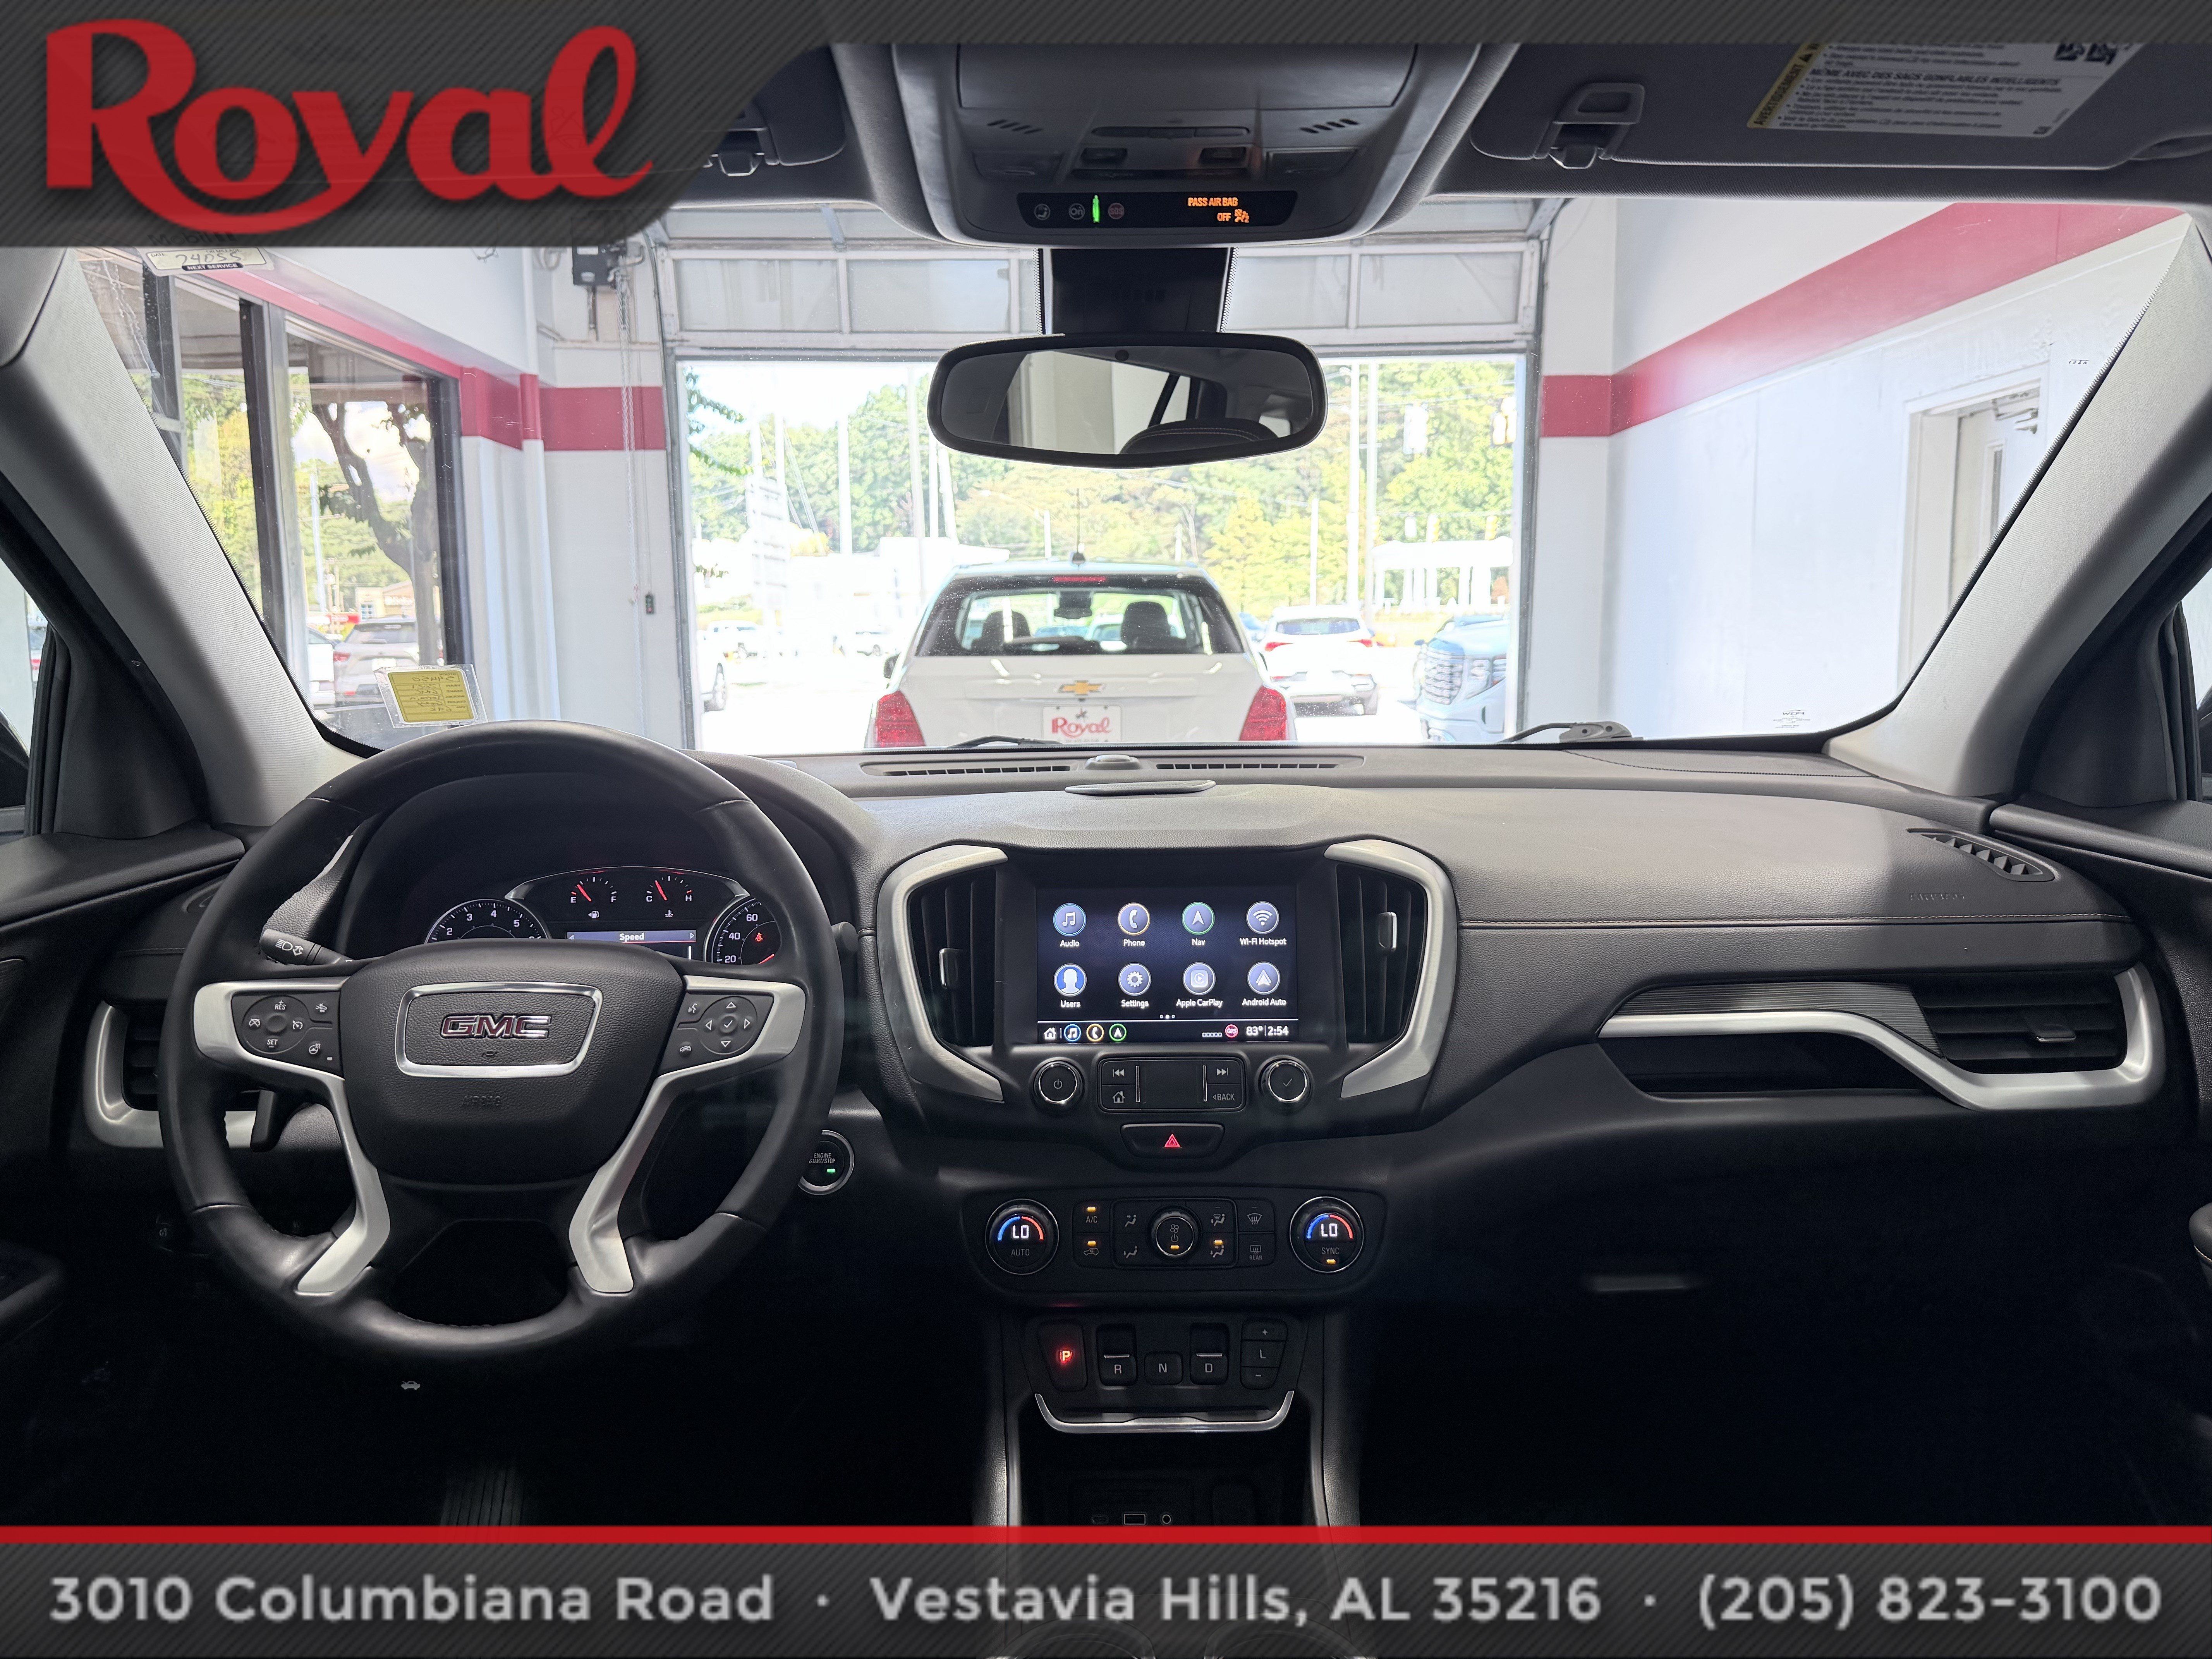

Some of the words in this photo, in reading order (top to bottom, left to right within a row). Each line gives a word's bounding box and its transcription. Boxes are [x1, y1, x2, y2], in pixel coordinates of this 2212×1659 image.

[1188, 198, 1207, 207] PASS
[1209, 198, 1222, 207] AIR
[1223, 198, 1238, 207] BAG
[1217, 213, 1231, 222] OFF
[1051, 717, 1112, 738] Royal
[466, 913, 472, 921] 3
[746, 914, 758, 922] 60
[513, 919, 520, 927] 5
[447, 927, 453, 936] 2
[619, 932, 644, 942] Speed
[728, 932, 740, 941] 40
[1259, 938, 1287, 947] Hotspot
[724, 955, 737, 964] 20
[1121, 1000, 1149, 1008] Settings
[1176, 999, 1197, 1008] Apple
[1197, 999, 1223, 1008] CarPlay
[1242, 998, 1269, 1006] Android
[441, 1014, 551, 1039] GMC
[1246, 1026, 1264, 1035] 83°
[1267, 1026, 1289, 1036] 2:54
[1217, 1093, 1235, 1101] BACK
[1012, 1225, 1029, 1239] LO
[1321, 1223, 1338, 1237] LO
[1060, 1350, 1072, 1361] P
[1259, 1350, 1266, 1359] L
[1115, 1364, 1122, 1374] R
[1159, 1363, 1167, 1373] N
[1205, 1363, 1212, 1373] D
